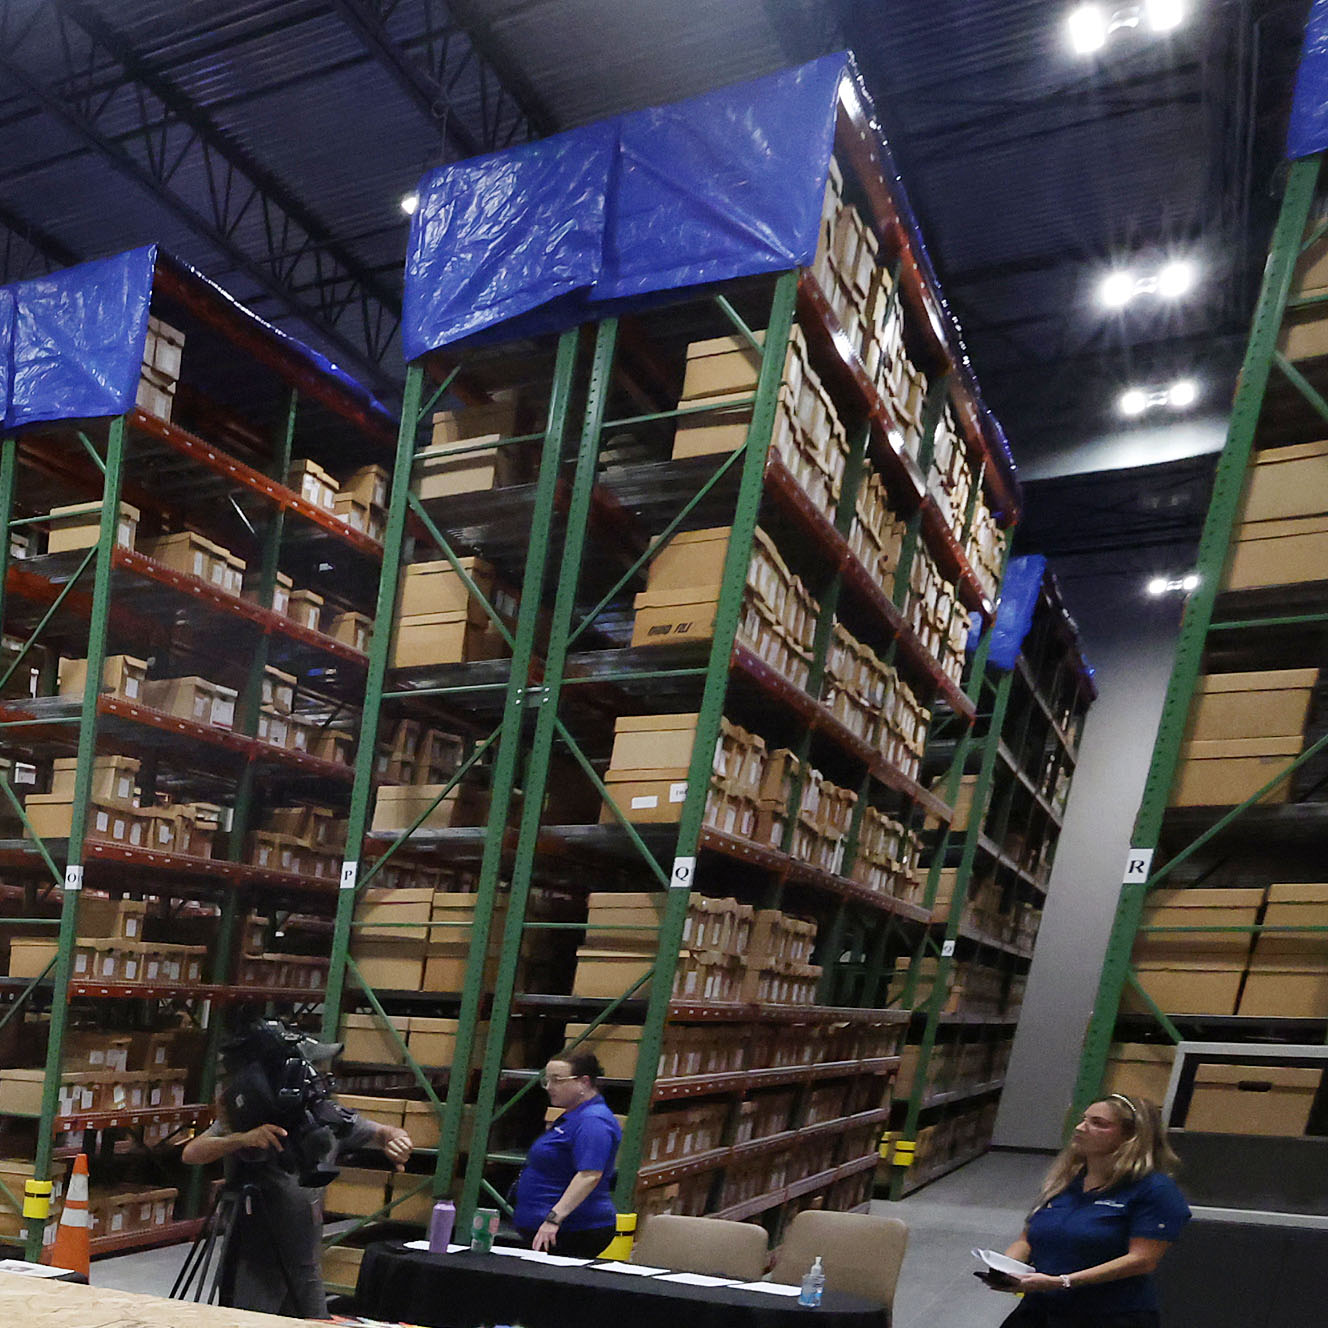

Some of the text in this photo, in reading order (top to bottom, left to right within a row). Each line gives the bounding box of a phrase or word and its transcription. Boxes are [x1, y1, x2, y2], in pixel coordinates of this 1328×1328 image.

[675, 866, 689, 881] Q
[1127, 859, 1145, 874] R
[344, 869, 353, 881] P
